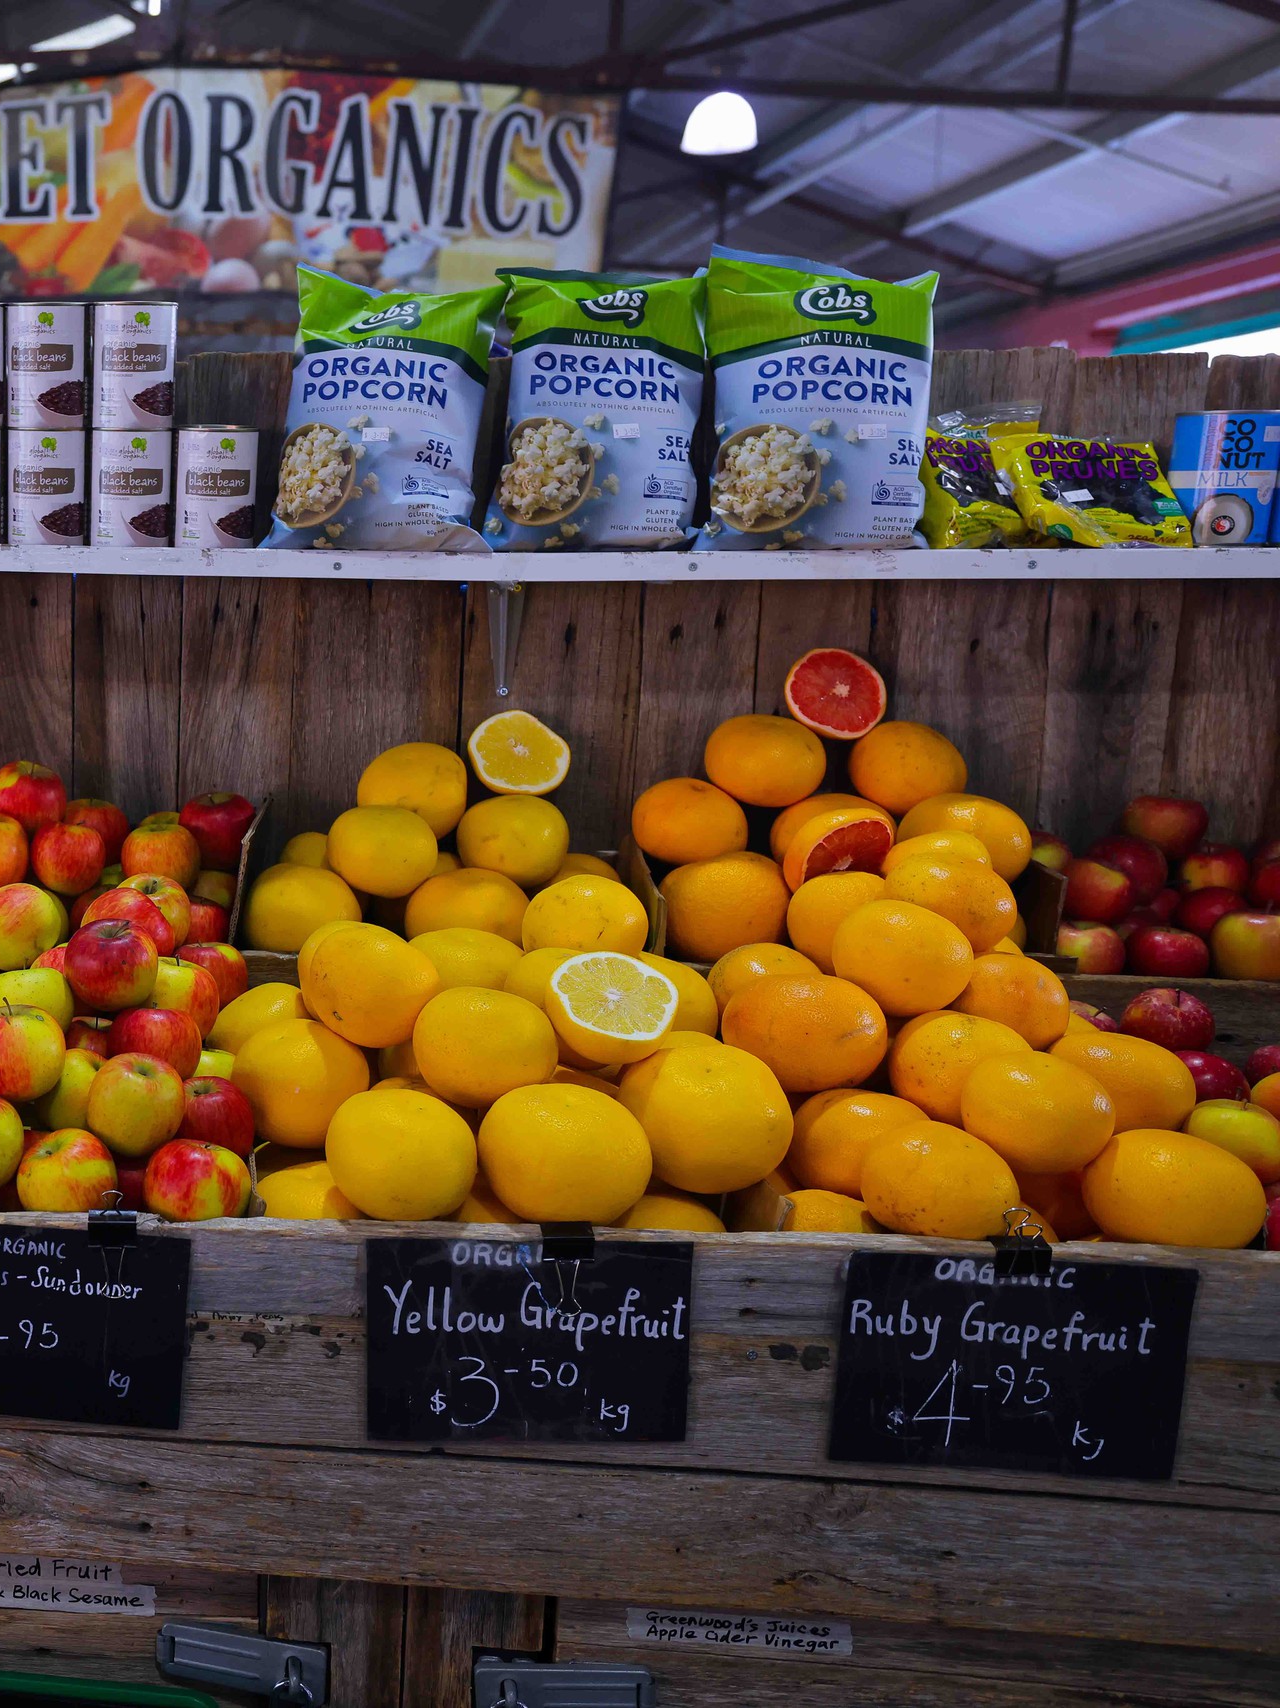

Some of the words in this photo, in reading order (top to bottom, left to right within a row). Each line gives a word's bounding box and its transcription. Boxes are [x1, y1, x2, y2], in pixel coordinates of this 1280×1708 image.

[140, 91, 589, 238] ORGANICS
[800, 286, 869, 320] Cobs
[346, 337, 414, 351] NATURAL
[573, 332, 640, 349] NATURAL
[800, 331, 872, 348] NATURAL
[36, 350, 67, 362] beans
[105, 350, 129, 362] black
[132, 350, 161, 362] beans
[535, 351, 675, 379] ORGANIC
[308, 356, 448, 383] ORGANIC
[757, 354, 908, 383] ORGANIC
[303, 379, 448, 409] POPCORN
[530, 375, 680, 404] POPCORN
[752, 379, 912, 407] POPCORN
[397, 407, 438, 420] ARTIFICIAL
[591, 403, 629, 411] NOTHING
[632, 406, 675, 414] ARTIFICIAL
[759, 407, 814, 415] ABSOLUTELY
[818, 407, 859, 415] NOTHING
[862, 409, 908, 418] ARTIFICIAL
[1220, 419, 1257, 436] CO
[426, 438, 453, 457] SEA
[665, 435, 690, 449] SEA
[1025, 441, 1150, 459] ORGANIC
[1217, 436, 1254, 453] CO
[414, 450, 452, 470] SALT
[1031, 459, 1159, 481] PRUNES
[1213, 452, 1265, 469] NUT
[40, 474, 69, 486] beans
[102, 474, 126, 486] black
[129, 474, 158, 487] beans
[189, 474, 214, 487] black
[217, 475, 245, 487] beans
[1197, 471, 1249, 487] MILK
[451, 1242, 543, 1267] ORGA
[934, 1258, 1075, 1288] ORGC
[383, 1279, 505, 1335] Yellow
[520, 1280, 685, 1352] Grapefruit
[849, 1299, 942, 1361] Ruby
[960, 1300, 1156, 1360] Grapefruit
[599, 1398, 630, 1432] kg
[52, 1559, 113, 1581] Fruit
[13, 1585, 61, 1603] Black
[68, 1588, 145, 1608] Sesame
[646, 1611, 759, 1632] Greenwood's
[766, 1620, 831, 1637] Juices
[646, 1624, 698, 1641] Apple
[765, 1633, 840, 1653] Vinegar
